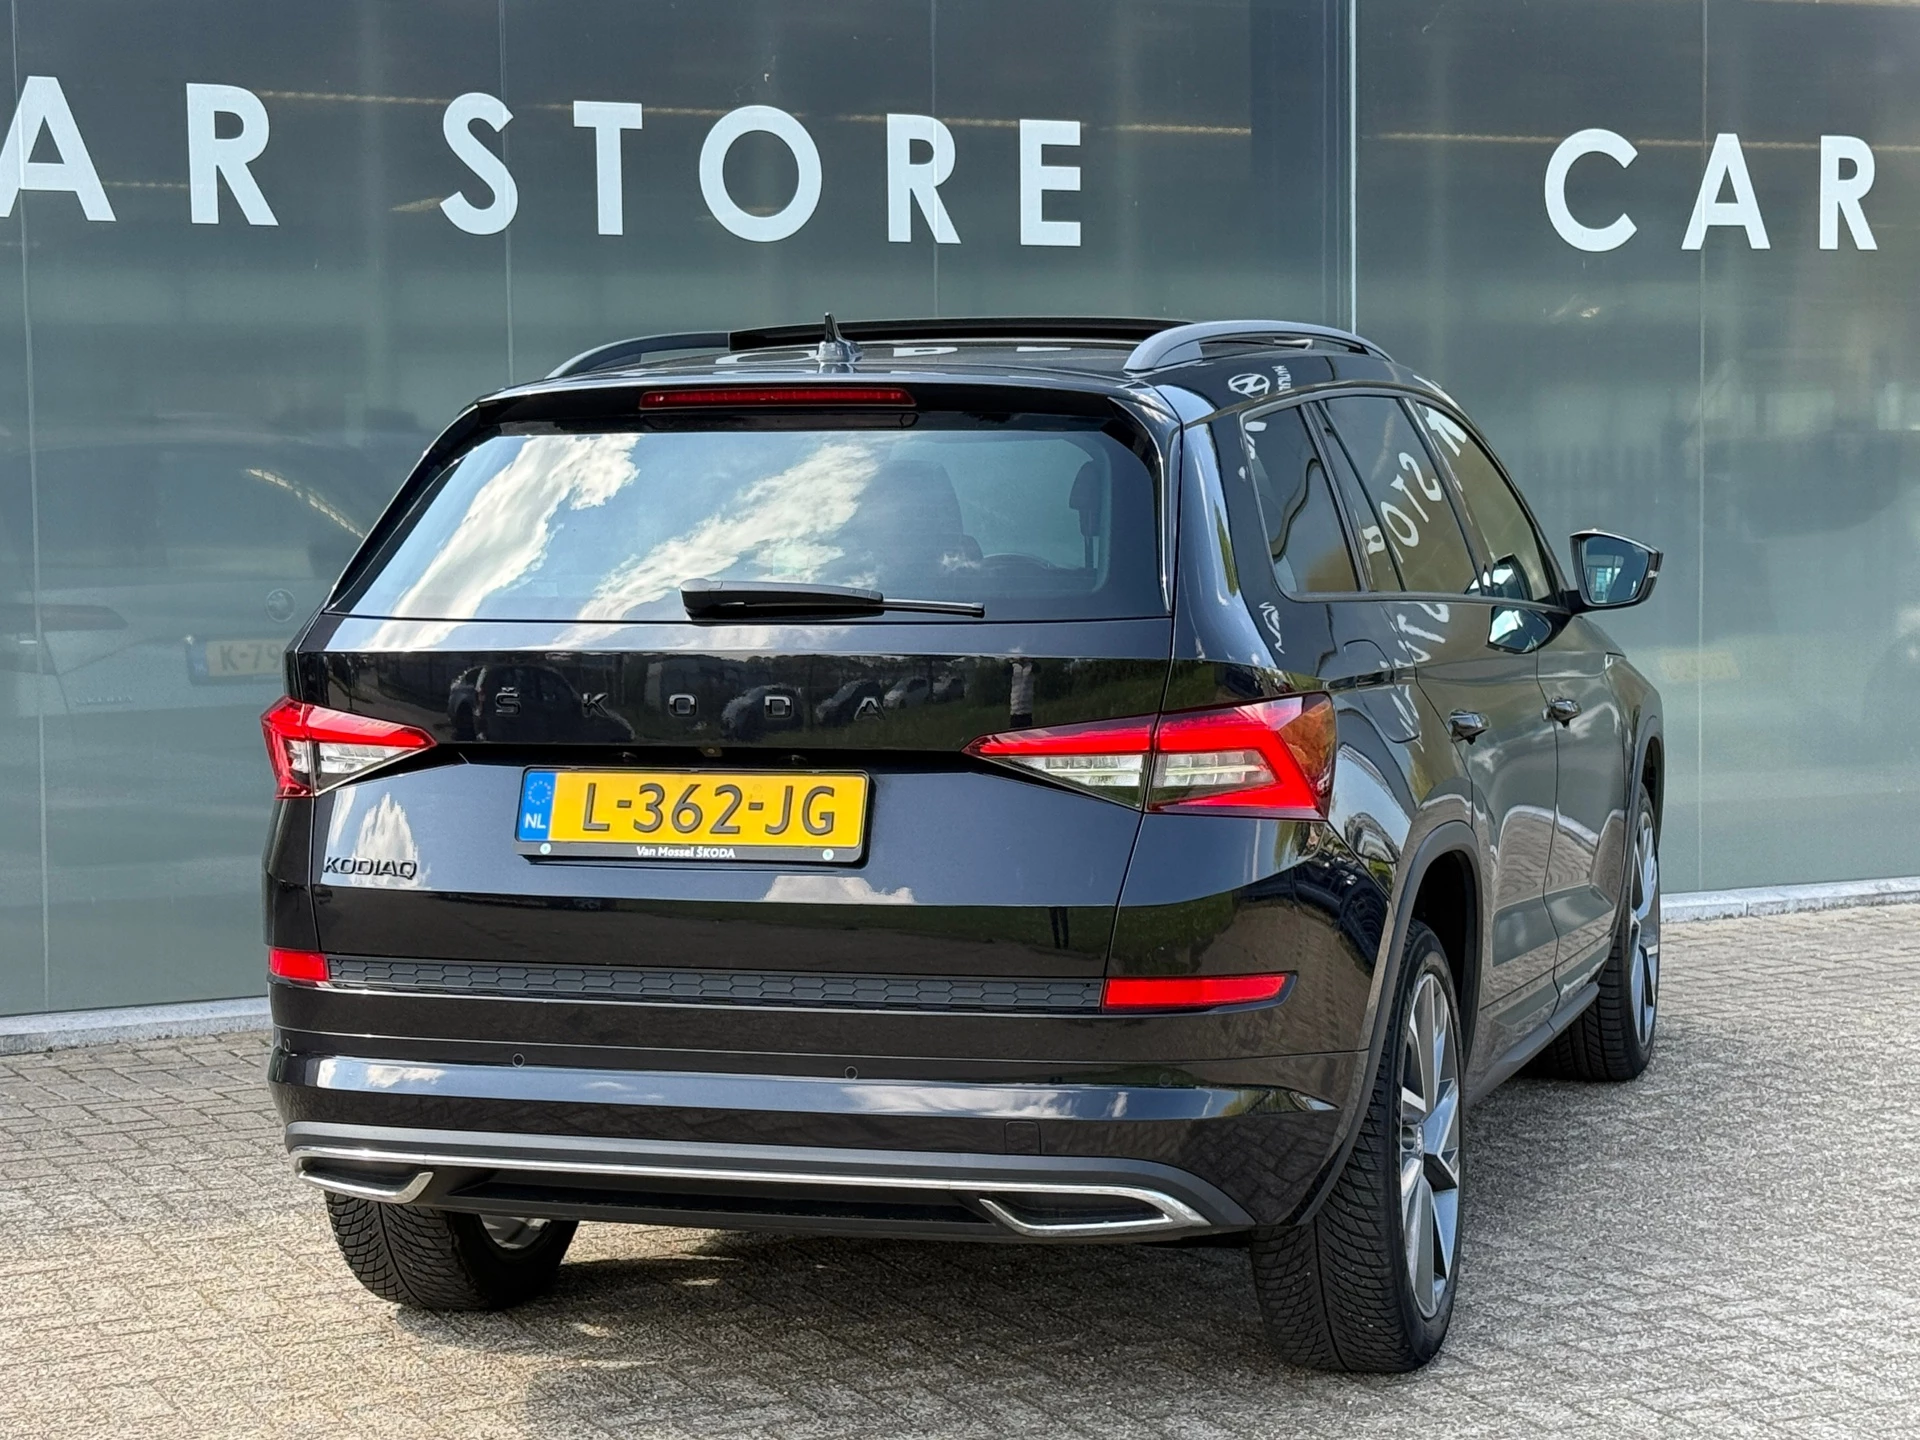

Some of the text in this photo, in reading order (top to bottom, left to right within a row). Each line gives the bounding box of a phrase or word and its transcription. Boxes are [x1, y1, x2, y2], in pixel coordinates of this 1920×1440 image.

[440, 91, 1081, 247] STORE
[1545, 128, 1878, 252] CAR
[494, 686, 887, 722] ŠKODA
[524, 782, 835, 836] NL L-362-JG
[322, 857, 418, 880] KODIAQ
[636, 845, 735, 858] Van Mossel ŠKODA
